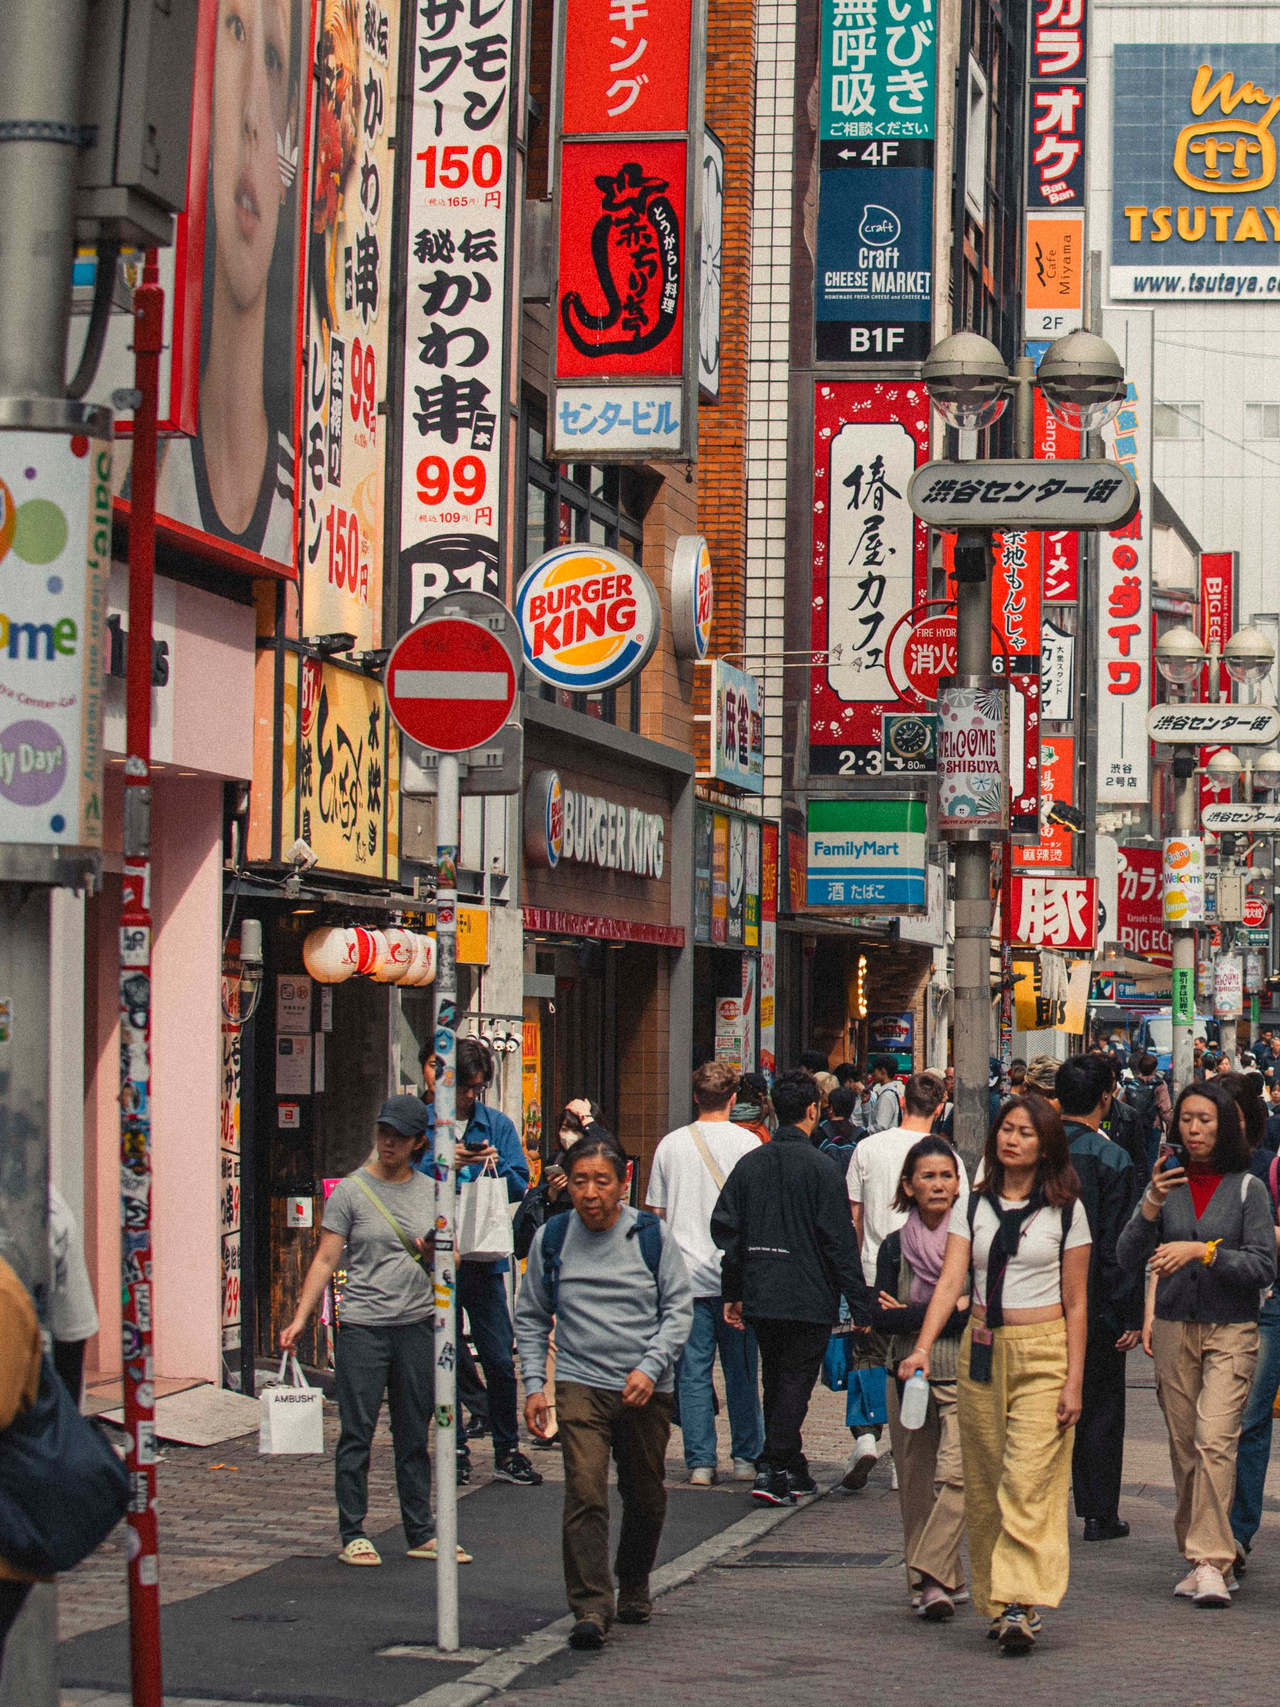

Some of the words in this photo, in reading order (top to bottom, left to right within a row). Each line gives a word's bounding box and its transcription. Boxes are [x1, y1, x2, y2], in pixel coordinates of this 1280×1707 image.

[419, 0, 465, 137] サワー
[1033, 0, 1082, 180] カラオケ
[829, 121, 929, 137] ご相談ください
[416, 144, 503, 189] 150
[861, 141, 899, 166] 4F
[484, 190, 502, 210] 円
[1041, 183, 1067, 197] Ban
[1049, 191, 1074, 204] Ban
[413, 228, 499, 264] 秘伝
[858, 247, 900, 269] Craft
[653, 206, 679, 315] とうがらし料理
[1048, 249, 1057, 279] Cafe
[1059, 234, 1072, 295] Miyama
[824, 271, 869, 287] CHEESE
[871, 271, 932, 293] MARKET
[1042, 316, 1064, 331] 2F
[850, 327, 905, 353] B1F
[413, 270, 493, 445] かわ串
[350, 336, 375, 429] 99
[559, 400, 680, 436] センタービル
[415, 454, 488, 506] 99
[921, 478, 1124, 504] 渋谷センター街
[474, 506, 493, 527] 円
[326, 503, 359, 594] 150
[842, 455, 903, 670] 椿屋カフェ
[528, 573, 633, 623] BURGER
[1207, 577, 1223, 618] BIG
[530, 596, 637, 658] KING
[916, 627, 934, 638] FIRE
[936, 627, 958, 638] HYDR
[910, 643, 958, 675] 消火
[1153, 715, 1273, 732] 渋谷センター街
[938, 728, 997, 759] WELCOME
[907, 761, 926, 770] 80m
[946, 760, 1001, 775] SHIBUYA
[1110, 763, 1133, 774] 渋谷
[1105, 776, 1138, 788] 2号店
[562, 789, 627, 872] BURGER
[628, 805, 665, 880] KING
[813, 841, 900, 860] FamilyMart
[1166, 848, 1189, 865] Enjoy
[827, 882, 845, 901] 酒
[850, 884, 886, 899] たばこ
[1016, 878, 1089, 945] 豚
[1127, 912, 1149, 923] Karaoke
